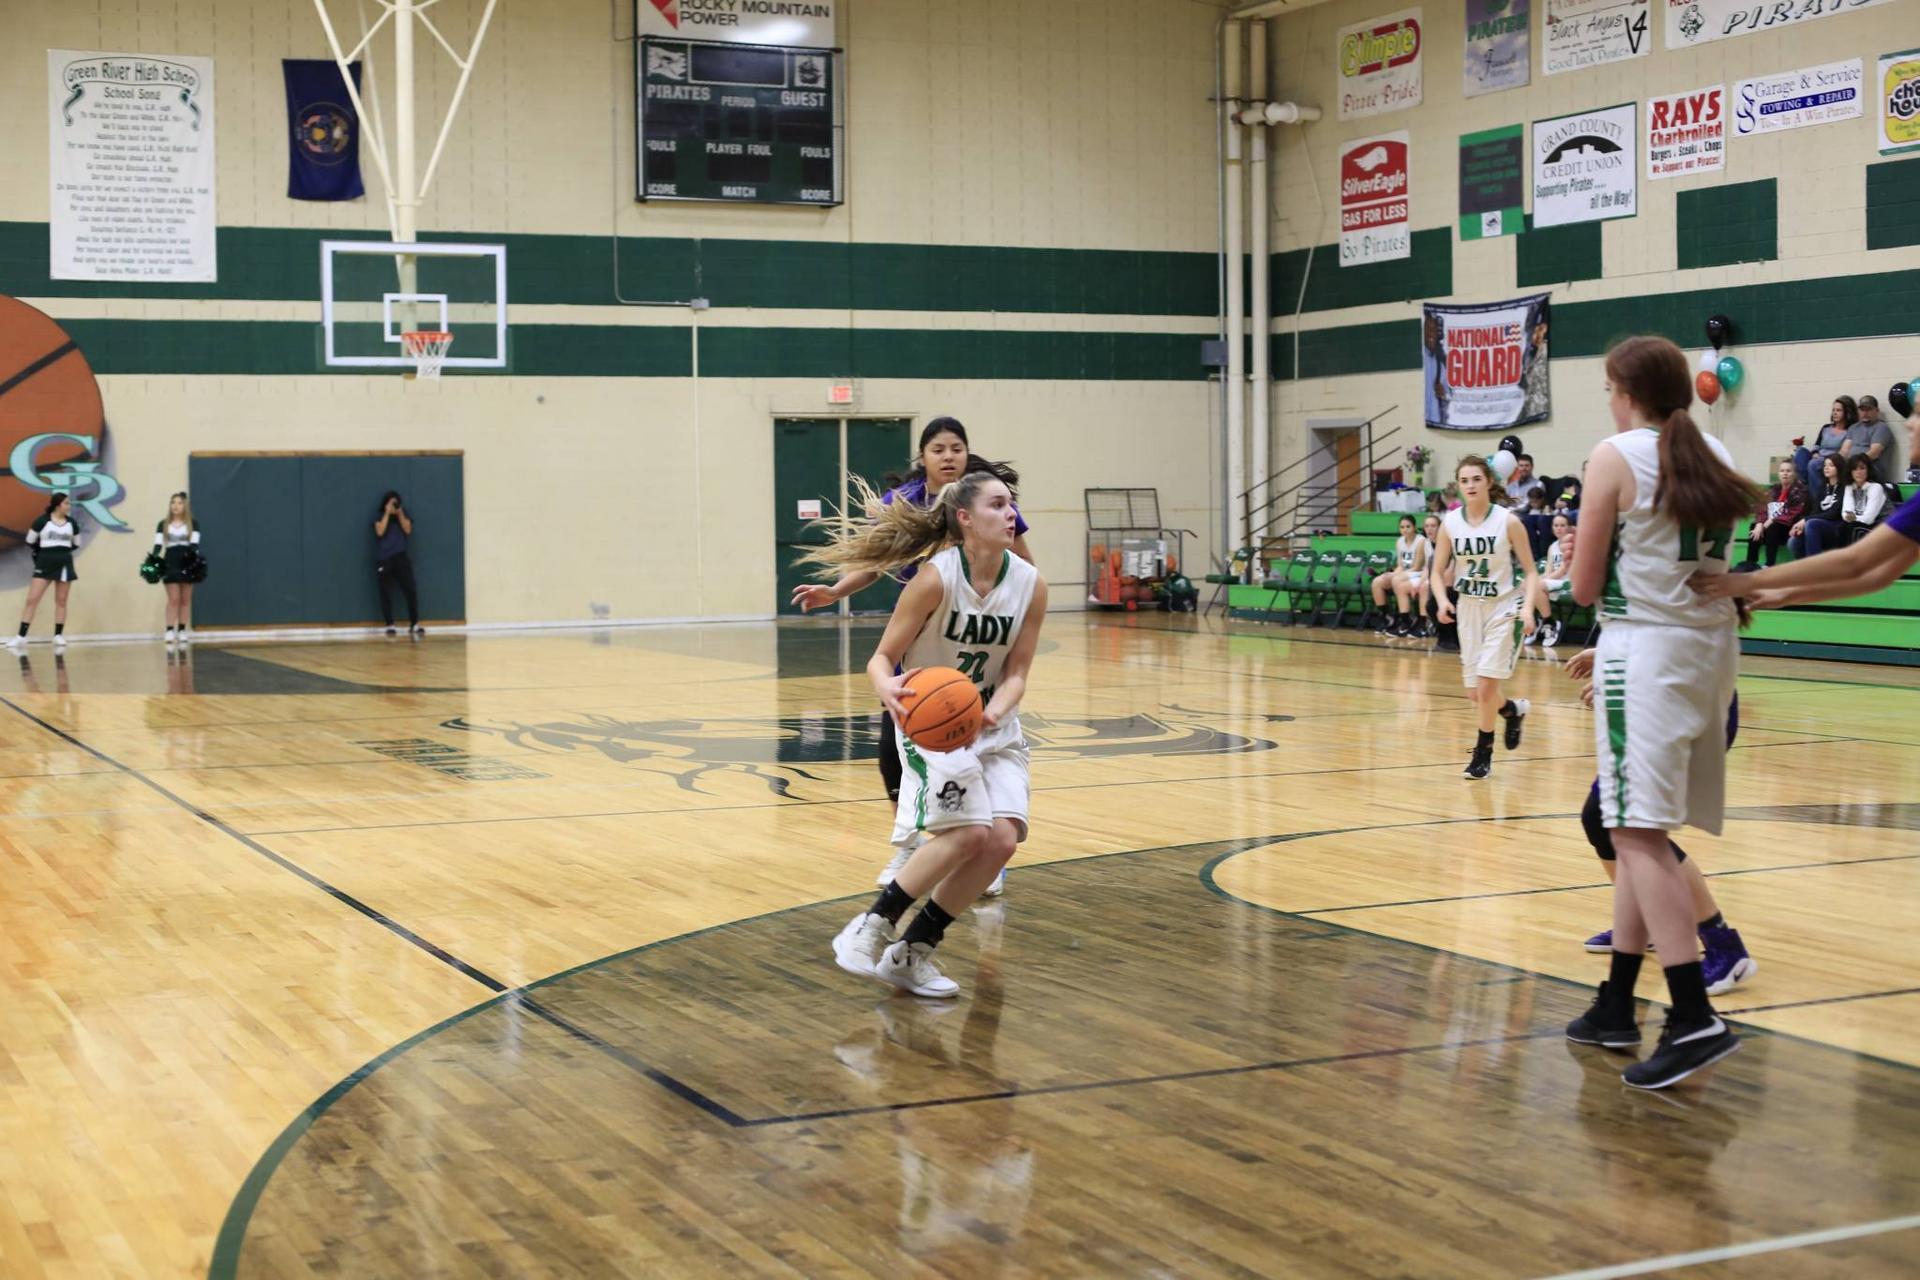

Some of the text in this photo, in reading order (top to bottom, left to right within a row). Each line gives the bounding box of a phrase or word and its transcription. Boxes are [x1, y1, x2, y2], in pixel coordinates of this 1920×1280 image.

[680, 11, 739, 26] POWER
[742, 2, 830, 17] MOUNTAIN
[1467, 13, 1529, 42] PIRATES
[1340, 26, 1416, 77] Blimpie
[68, 65, 97, 82] Green
[102, 62, 131, 81] River
[135, 62, 159, 82] High
[1755, 66, 1861, 98] Garage & Service
[104, 87, 161, 100] School Song
[647, 84, 711, 101] PIRATES
[721, 96, 756, 108] PERIOD
[781, 91, 826, 107] GUEST
[1762, 89, 1854, 114] TOWING & REPAIR
[1651, 91, 1721, 131] RAYS
[1540, 117, 1625, 154] GRAND COUNTY
[1651, 121, 1722, 147] Charbroiled
[706, 143, 773, 156] PLAYER FOUL
[800, 146, 831, 158] FOULS
[1543, 154, 1623, 180] CREDIT UNION
[722, 186, 757, 198] MATCH
[1342, 169, 1406, 198] SilverEagle
[801, 189, 831, 200] SCORE
[1601, 193, 1613, 208] the
[1343, 204, 1407, 227] GAS FOR LESS
[1342, 238, 1357, 260] Go
[1448, 326, 1505, 348] NATIONAL
[1447, 345, 1521, 388] GUARD
[1454, 536, 1496, 556] LADY
[1466, 559, 1490, 578] 24
[944, 611, 1014, 646] LADY
